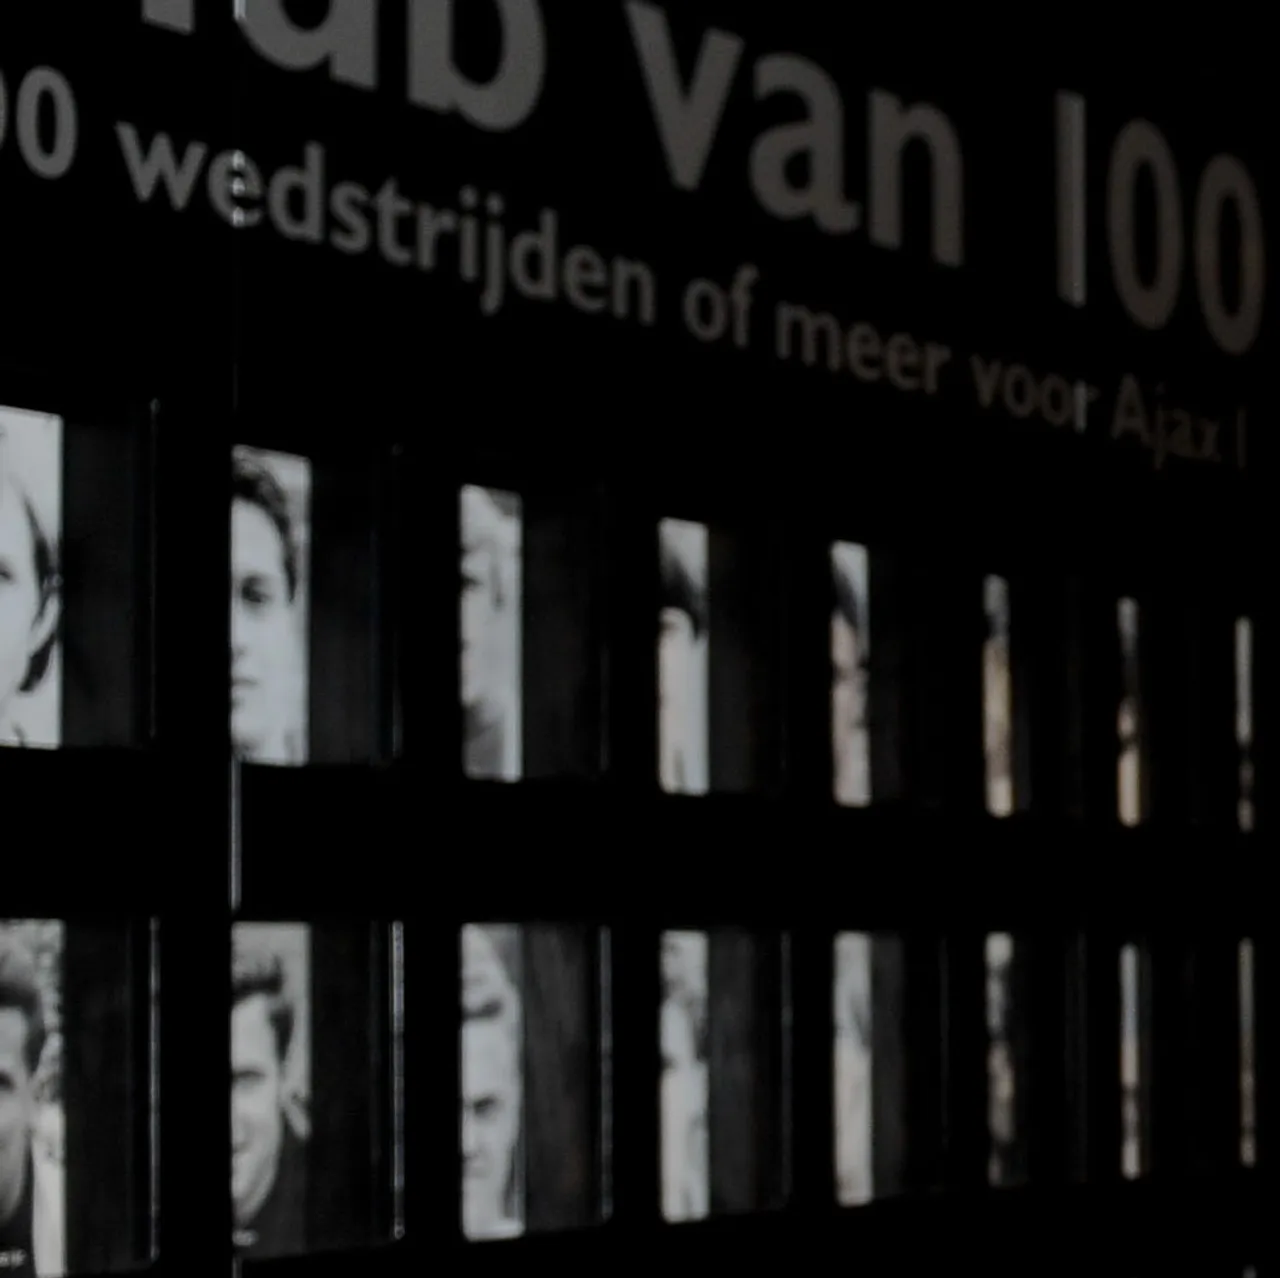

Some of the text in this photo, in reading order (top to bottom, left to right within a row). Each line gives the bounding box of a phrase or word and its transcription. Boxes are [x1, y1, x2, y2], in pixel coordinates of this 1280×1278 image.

[114, 121, 656, 324] wedstrijden
[682, 264, 759, 347] of
[776, 302, 951, 393] meer
[970, 354, 1100, 433] voor
[1111, 374, 1221, 469] Ajax
[623, 0, 963, 267] van
[1057, 90, 1264, 353] 100
